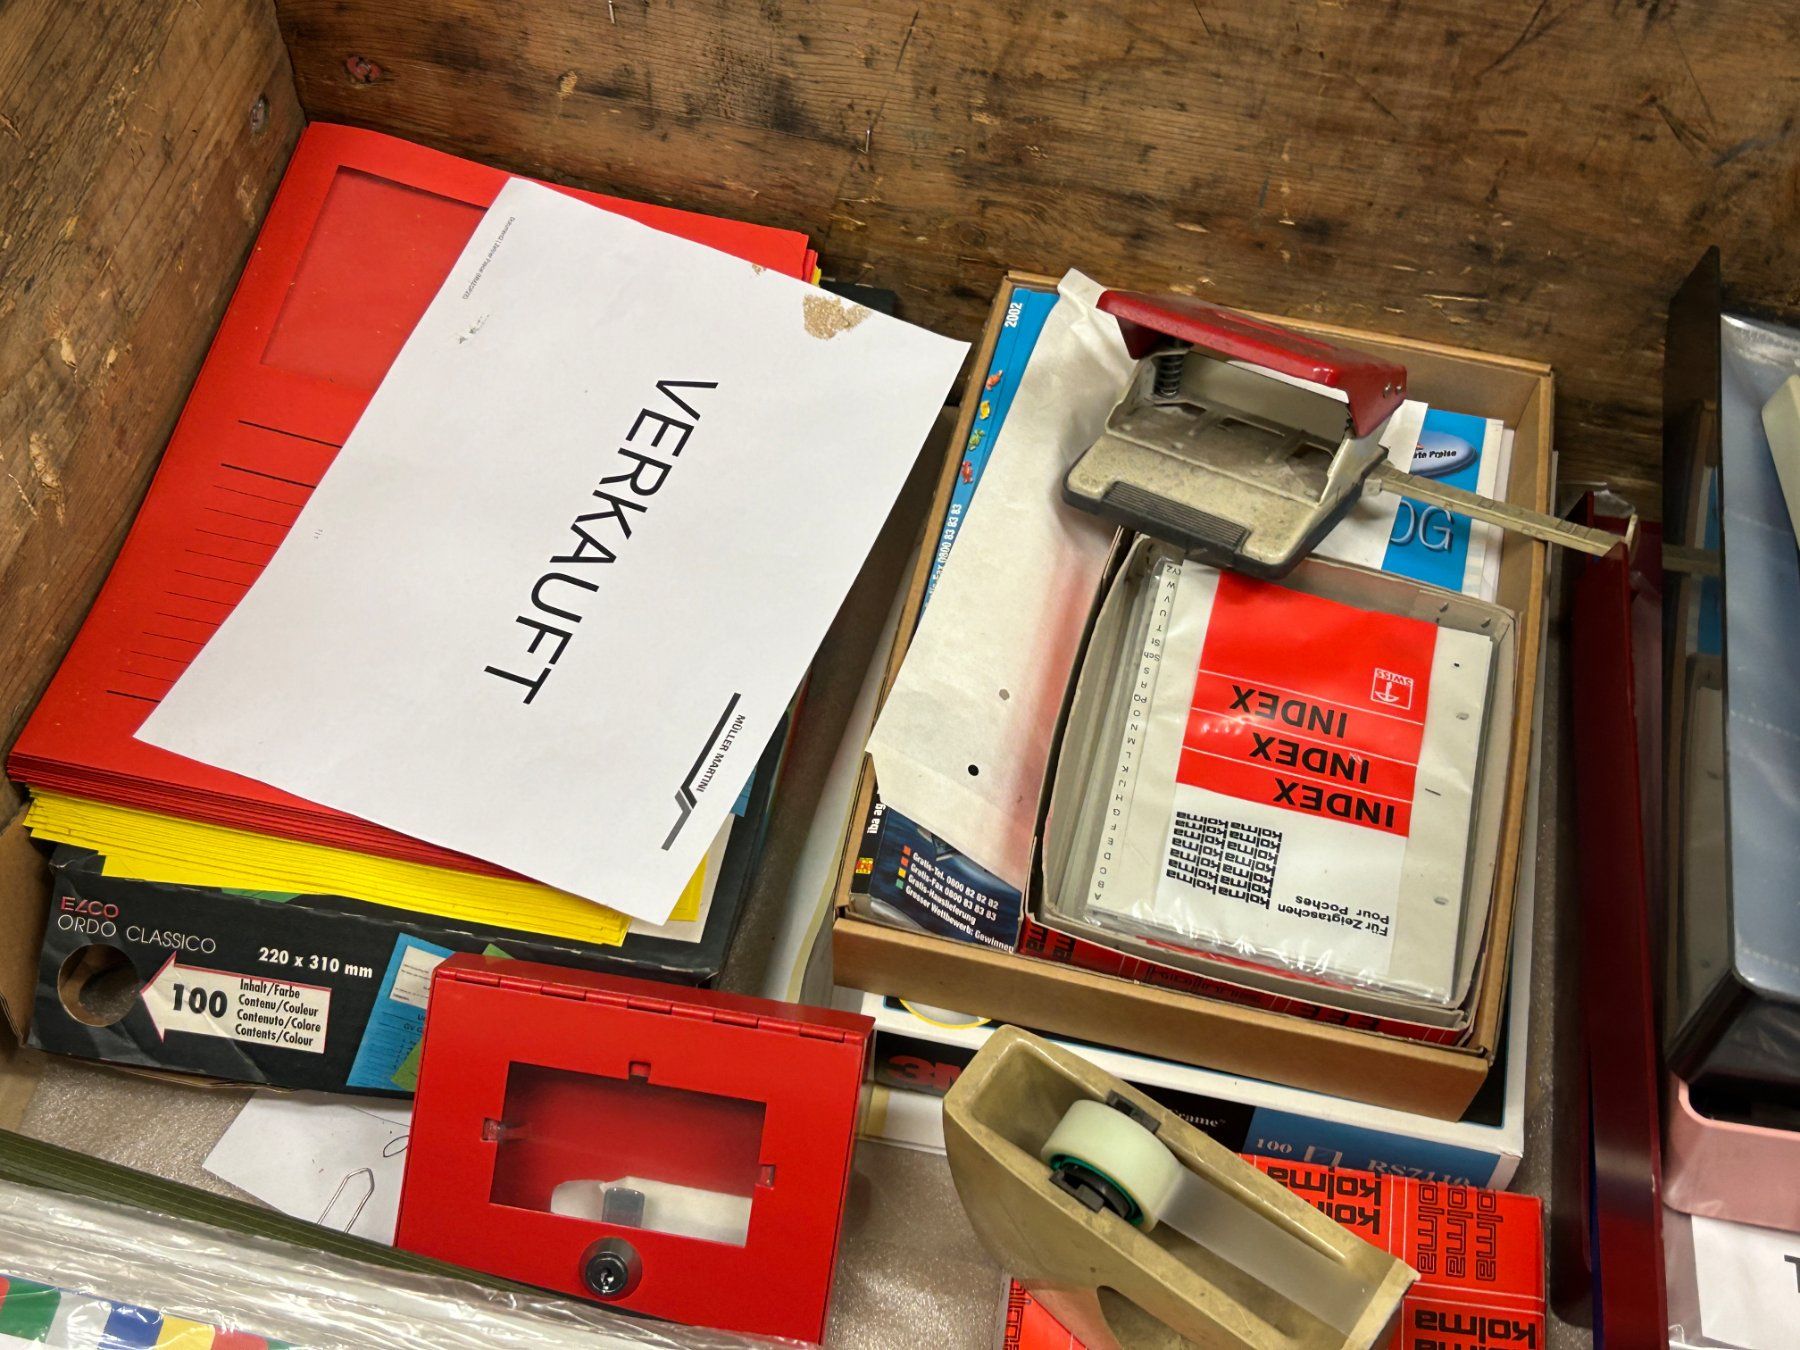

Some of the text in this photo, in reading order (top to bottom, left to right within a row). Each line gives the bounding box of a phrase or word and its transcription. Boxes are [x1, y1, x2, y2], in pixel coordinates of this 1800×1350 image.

[1004, 302, 1023, 328] 2002
[947, 516, 959, 528] 83
[951, 503, 962, 515] 83
[483, 379, 719, 705] VERKAUFT
[944, 529, 956, 540] 83
[1143, 652, 1161, 662] Sch
[1140, 681, 1147, 689] R
[1375, 669, 1414, 687] SWISS
[1130, 723, 1138, 731] N
[1229, 684, 1348, 739] INDEX
[696, 714, 746, 793] MÜLLER MARTINI
[1126, 751, 1132, 759] L
[1127, 737, 1136, 745] M
[1122, 765, 1129, 773] K
[1249, 732, 1370, 784] INDEX
[1113, 808, 1121, 816] G
[1272, 777, 1395, 828] INDEX
[1107, 837, 1114, 846] E
[1110, 823, 1117, 831] F
[1174, 819, 1281, 852] kolma kolma
[1176, 811, 1283, 842] kolma kolma
[1104, 852, 1111, 861] D
[1171, 837, 1276, 876] kolma kolma
[1173, 828, 1279, 865] kolma kolma
[912, 852, 945, 881] Gratis-Tel.
[946, 875, 964, 892] 0800
[1167, 858, 1272, 899] kolma kolma
[1169, 848, 1274, 888] kolma kolma
[905, 885, 931, 908] Grosser
[908, 874, 977, 926] Gratis-Hauslieferung
[910, 862, 944, 892] Gratis-Fax
[985, 909, 997, 922] 83
[1094, 892, 1102, 901] A
[1097, 880, 1105, 889] B
[1165, 868, 1270, 910] kolma kolma
[1277, 903, 1388, 936] Für Zeigtaschen
[1295, 895, 1390, 925] Pour Poches
[57, 914, 217, 954] ORDO CLASSICO
[258, 947, 373, 979] 220 x 310 mm
[172, 983, 228, 1018] 100
[239, 978, 301, 999] Inhalt/Farbe
[236, 1008, 321, 1032] Contenuto/Colore
[238, 994, 320, 1017] Contenu/Couleur
[235, 1023, 314, 1047] Contents/Colour
[1256, 1137, 1293, 1154] 100
[1266, 1165, 1382, 1206] kolma
[1307, 1199, 1381, 1236] kol
[1416, 1184, 1445, 1275] olma
[1445, 1187, 1474, 1279] olma
[1475, 1190, 1504, 1282] olma
[1414, 1309, 1536, 1350] kolma
